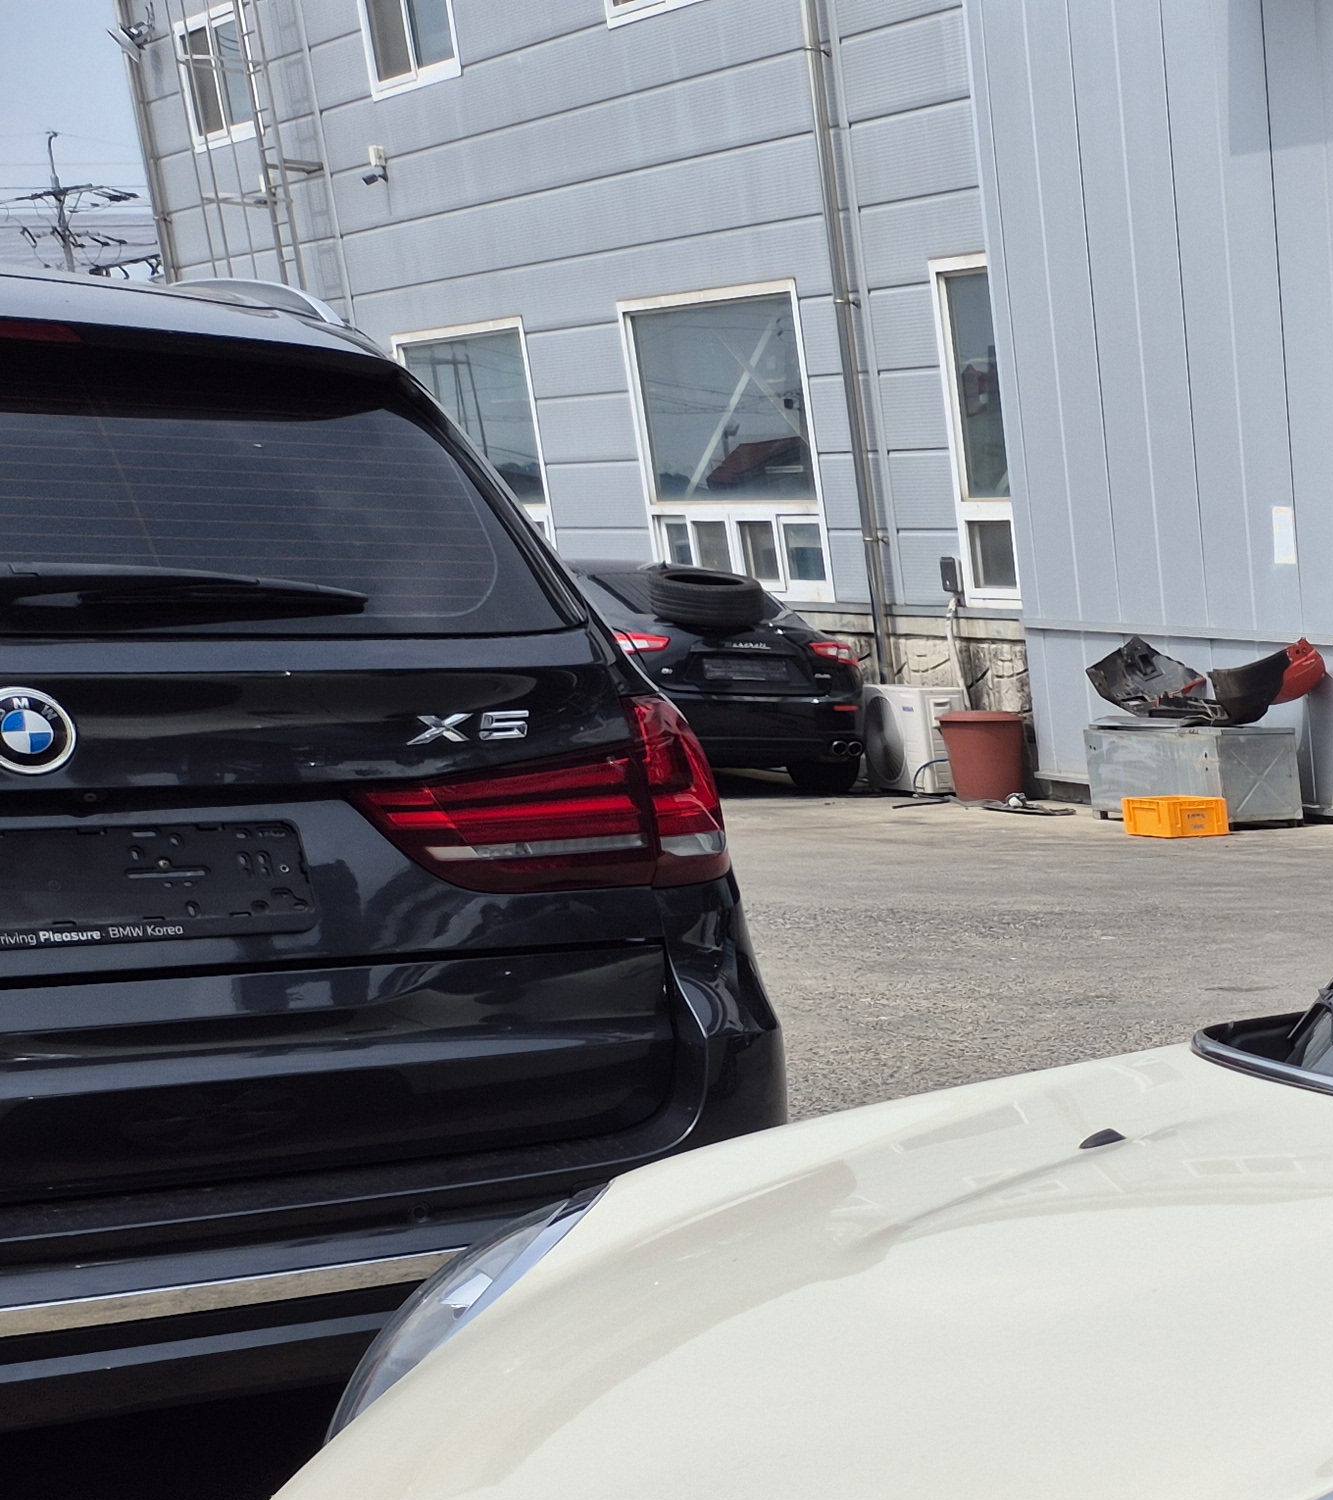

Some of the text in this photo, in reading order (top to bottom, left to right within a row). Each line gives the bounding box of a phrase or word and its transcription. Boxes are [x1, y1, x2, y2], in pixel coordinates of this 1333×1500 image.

[406, 710, 530, 745] X5
[39, 930, 101, 943] Pleasure
[108, 926, 143, 939] BMW
[147, 924, 184, 936] Korea
